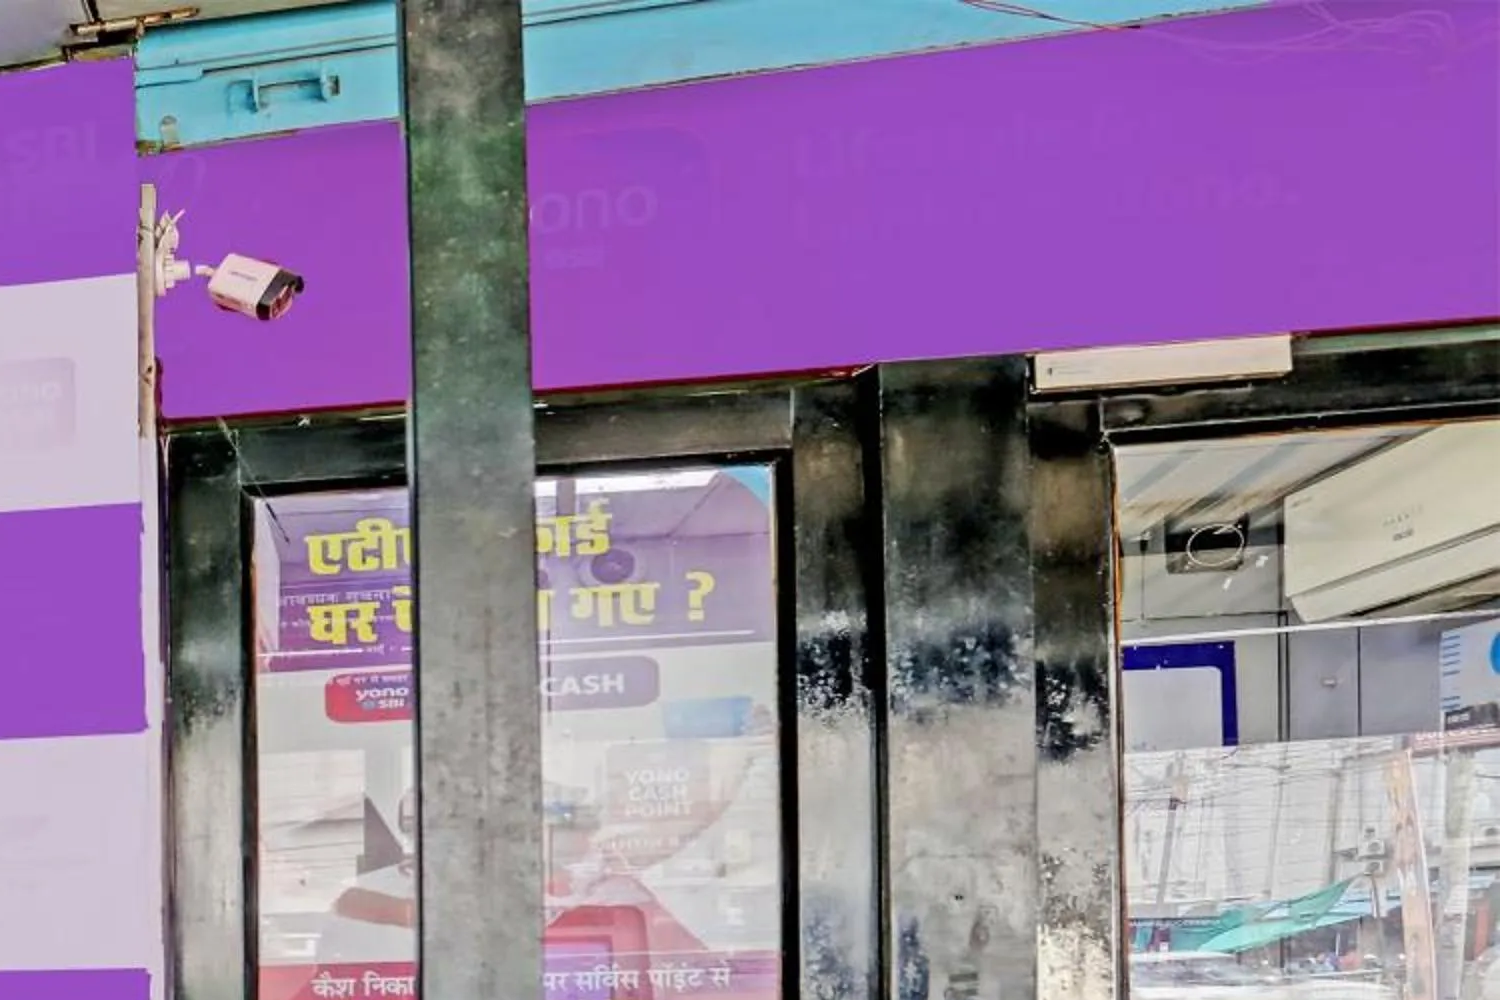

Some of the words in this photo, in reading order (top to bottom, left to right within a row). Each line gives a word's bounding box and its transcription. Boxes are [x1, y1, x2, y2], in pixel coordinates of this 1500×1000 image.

[306, 601, 380, 646] घर
[568, 582, 661, 627] गए
[685, 570, 716, 622] ?
[363, 970, 415, 996] निका
